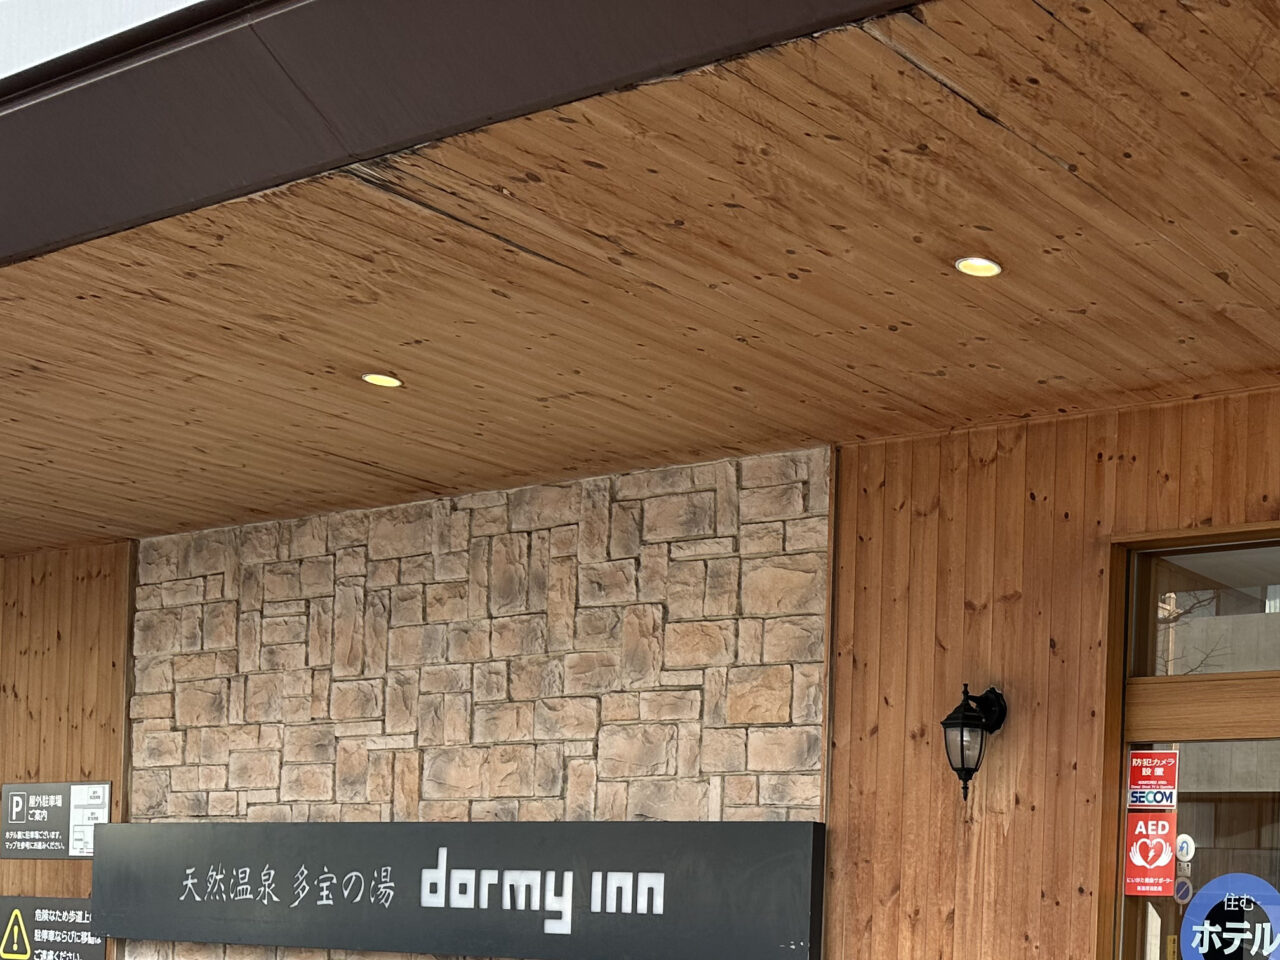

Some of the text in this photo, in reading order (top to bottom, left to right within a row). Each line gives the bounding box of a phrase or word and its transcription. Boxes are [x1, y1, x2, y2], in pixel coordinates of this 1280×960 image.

[1132, 758, 1175, 767] 防犯カメラ
[28, 794, 63, 808] 屋外駐車場
[1131, 791, 1173, 804] SECOM
[12, 795, 23, 821] P
[27, 809, 48, 822] ご案内
[1134, 820, 1170, 836] AED
[179, 847, 665, 935] 天然温泉 多宝の湯 dormy inn
[1223, 892, 1256, 911] 住む
[34, 908, 92, 924] 危険なため歩道上
